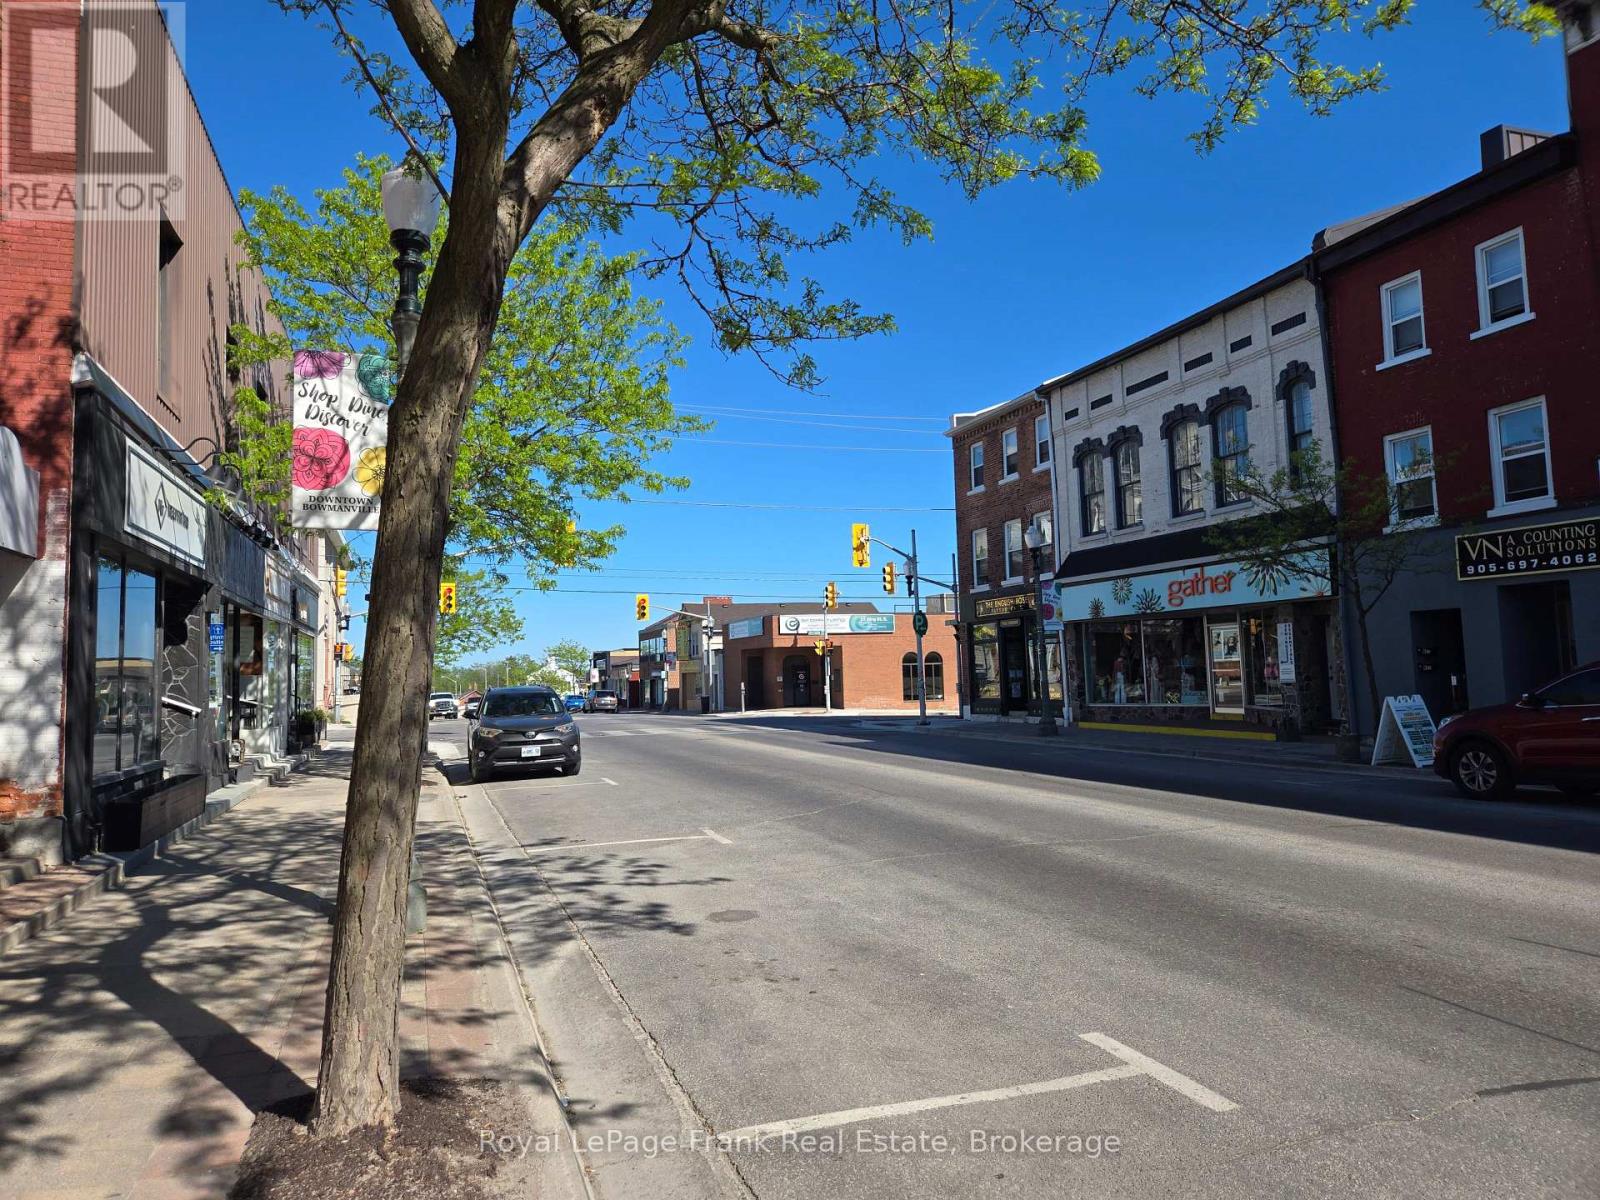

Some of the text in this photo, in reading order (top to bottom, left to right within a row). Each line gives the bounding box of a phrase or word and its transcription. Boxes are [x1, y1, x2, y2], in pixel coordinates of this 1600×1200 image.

[298, 381, 386, 419] Shop Dine
[304, 403, 369, 437] Discover
[302, 503, 379, 514] BOWMANVILLE
[309, 495, 374, 506] DOWNTOWN
[1523, 524, 1596, 544] COUNTING
[1463, 535, 1503, 561] VN
[1507, 537, 1597, 558] SOLUTIONS
[1466, 552, 1597, 575] 905-697-4062
[1168, 564, 1236, 607] gather
